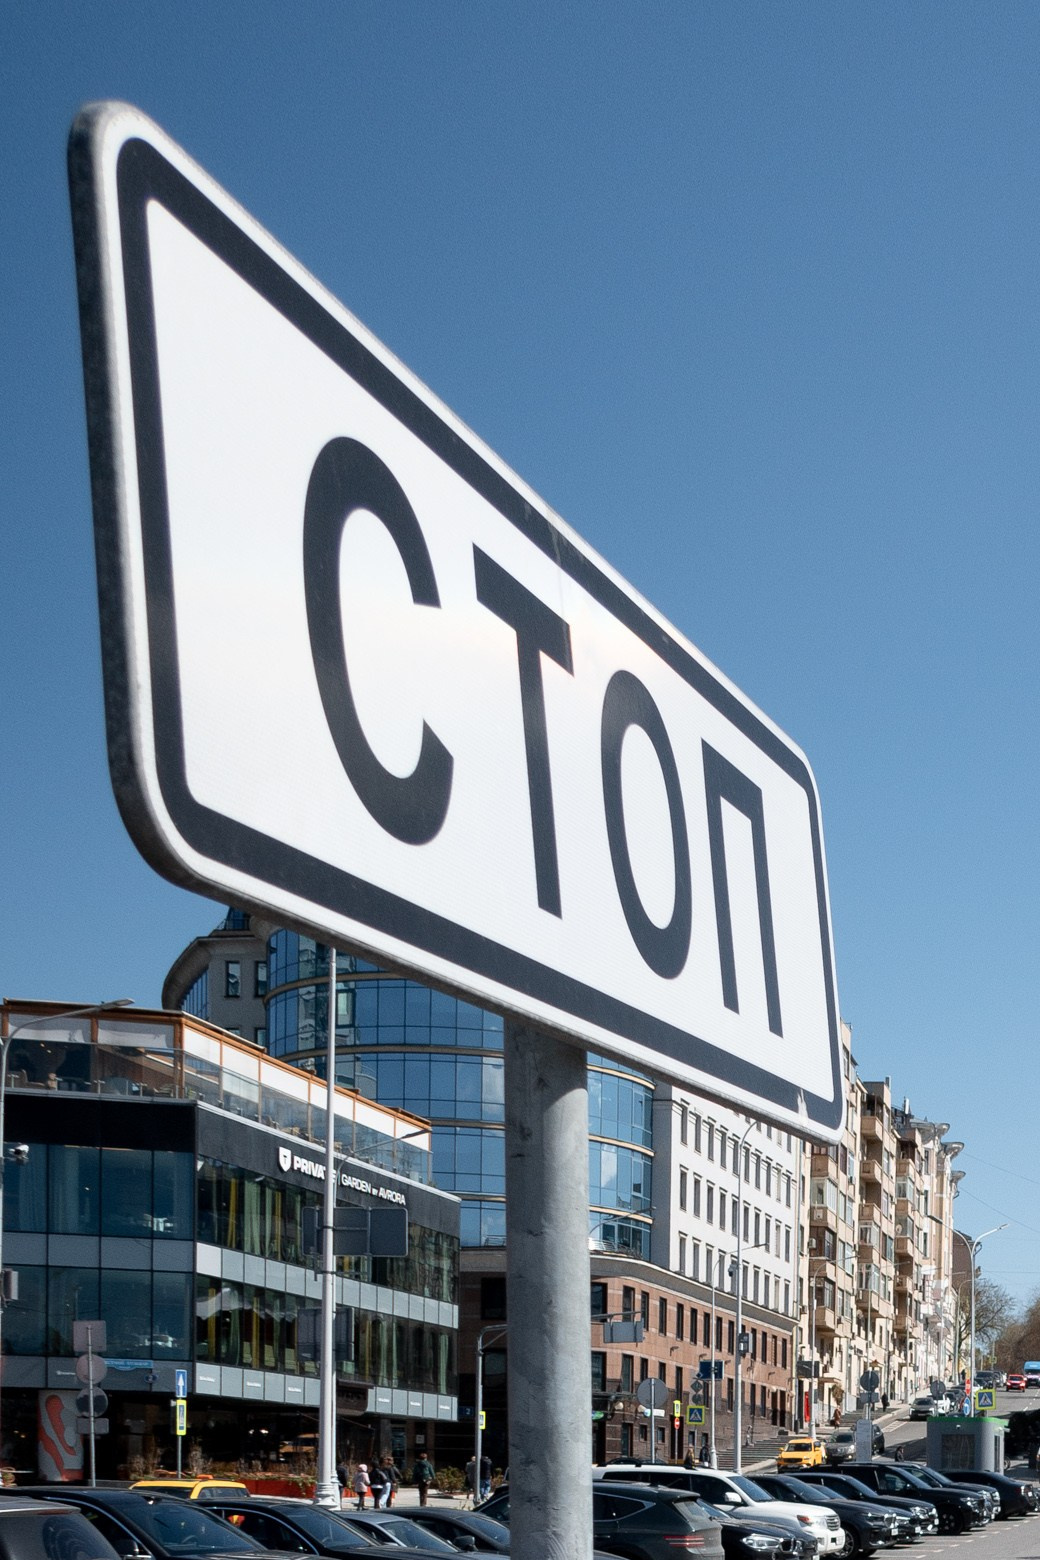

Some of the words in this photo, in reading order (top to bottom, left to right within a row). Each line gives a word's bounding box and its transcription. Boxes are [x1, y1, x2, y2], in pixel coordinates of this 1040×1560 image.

[303, 436, 783, 1037] СТОП
[293, 1155, 336, 1184] PRIVAE
[341, 1173, 371, 1194] GARDEN
[378, 1187, 406, 1206] AVRORA
